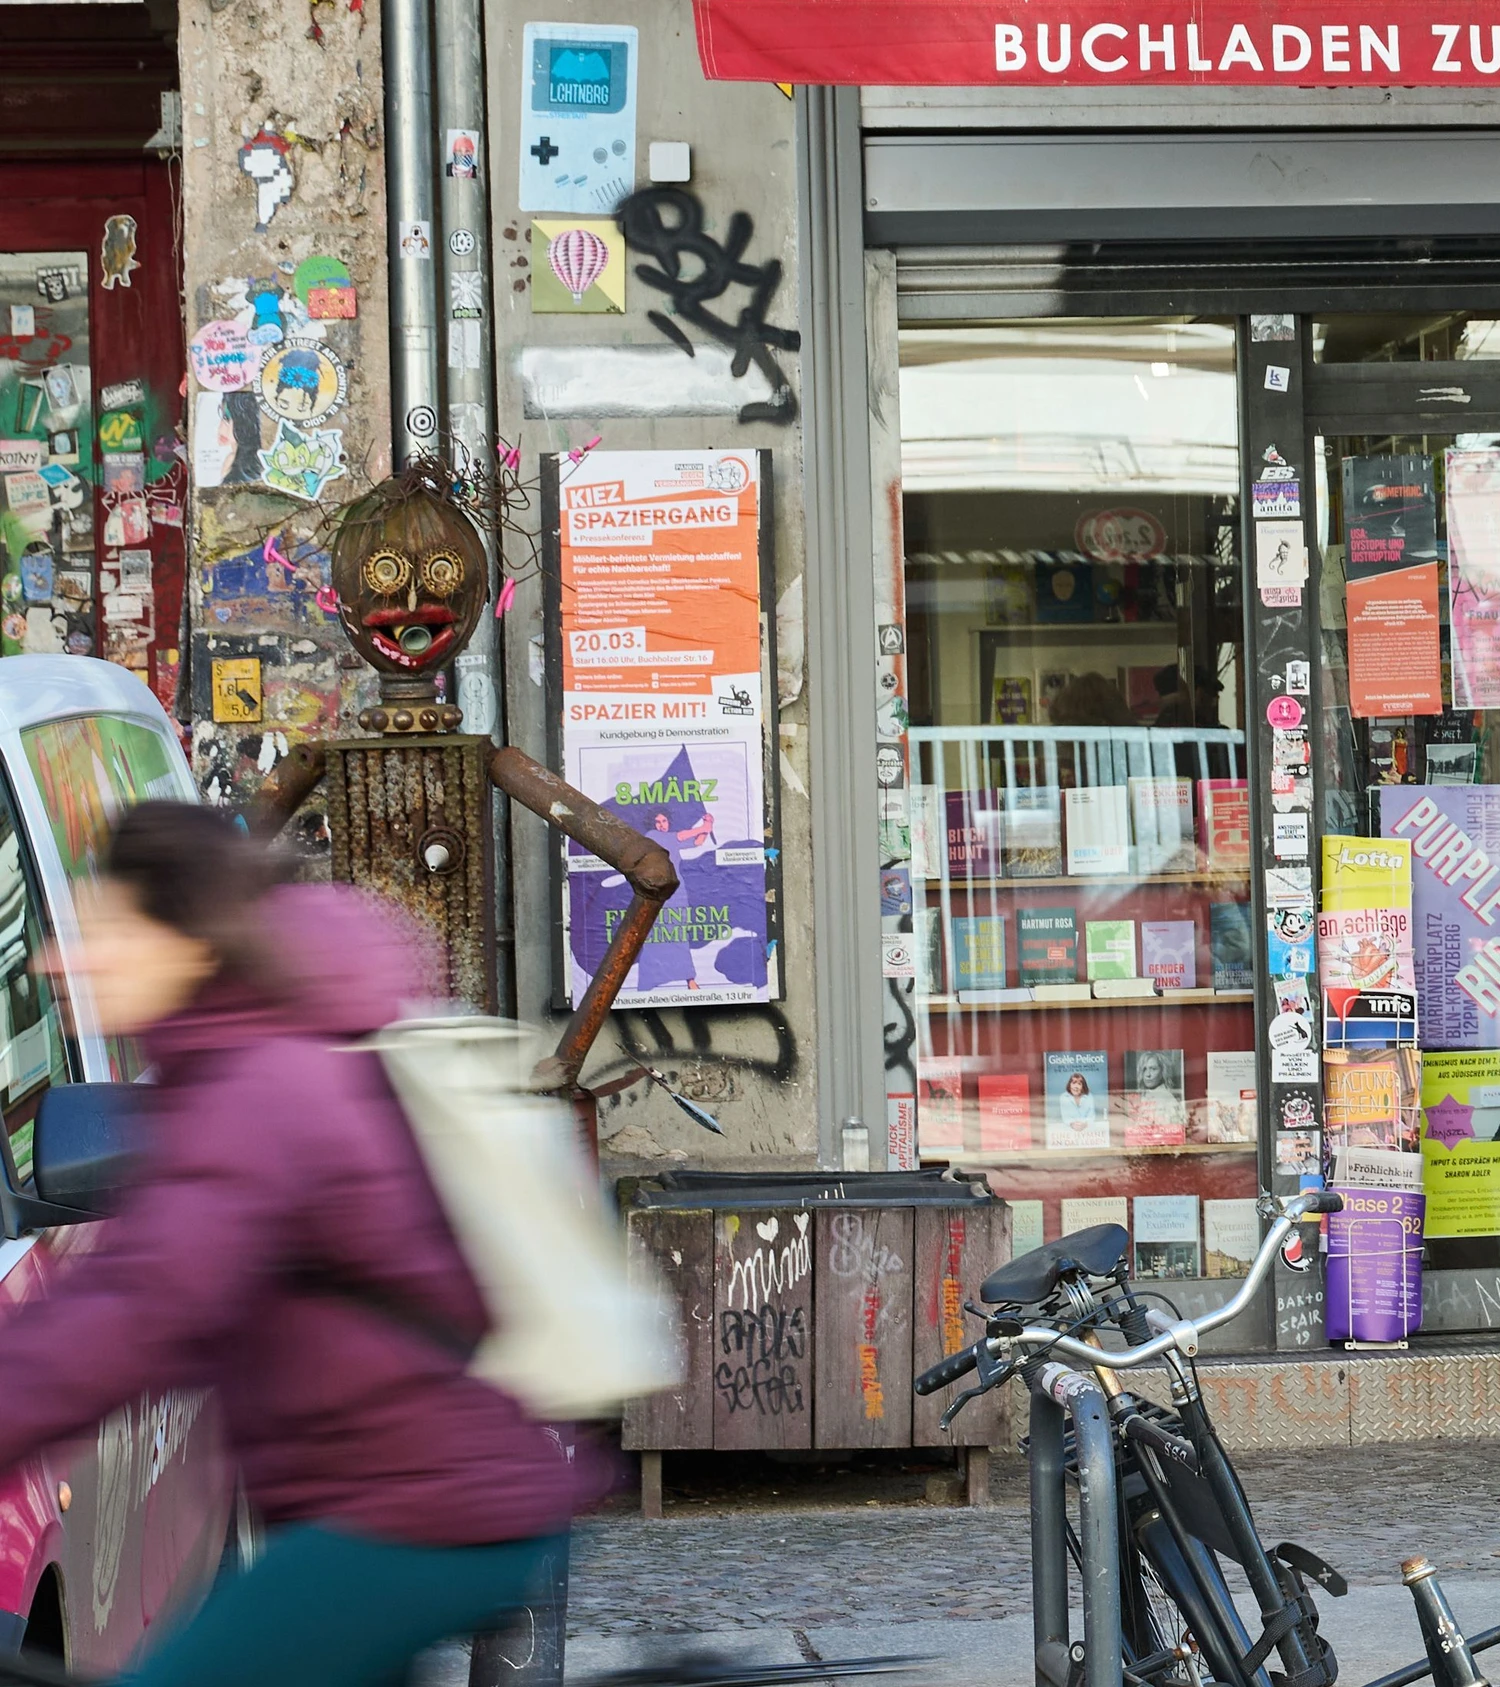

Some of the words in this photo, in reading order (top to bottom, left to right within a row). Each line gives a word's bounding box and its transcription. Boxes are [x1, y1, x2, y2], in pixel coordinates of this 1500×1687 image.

[993, 23, 1401, 73] BUCHLADEN
[550, 82, 609, 105] LCHTNBRG
[284, 338, 321, 351] STREET
[321, 348, 341, 364] ART
[336, 364, 347, 403] CONTRA
[302, 415, 327, 428] ODIO
[569, 483, 622, 508] KIEZ
[1260, 504, 1293, 513] antifa
[573, 505, 731, 530] SPAZIERGANG
[580, 534, 645, 542] Pressekonferenz
[1351, 539, 1387, 551] DYSTOPIE
[1388, 538, 1405, 550] UND
[649, 554, 695, 563] Vermietung
[696, 552, 742, 561] abschaffen!
[573, 566, 587, 574] Für
[588, 565, 611, 573] echte
[612, 564, 671, 574] Nachbarschaft!
[574, 632, 642, 653] 20.03.
[575, 656, 595, 665] Start
[620, 655, 637, 666] Uhr,
[638, 655, 682, 664] Buchholzer
[684, 654, 697, 663] Str.
[698, 655, 708, 663] 16
[231, 704, 250, 717] 5,0
[570, 703, 656, 721] SPAZIER
[662, 702, 707, 719] MIT!
[599, 729, 657, 740] Kundgebung
[666, 727, 729, 737] Demonstration
[615, 777, 719, 805] 8.MÄRZ
[1467, 793, 1482, 841] FIGHTS
[1485, 793, 1500, 857] FEMINIST
[949, 827, 985, 844] BITCH
[949, 844, 984, 861] HUNT
[1339, 847, 1404, 868] Lotta
[1021, 917, 1053, 930] HARTMUT
[1054, 917, 1074, 929] ROSA
[1148, 963, 1185, 975] GENDER
[1426, 912, 1443, 1039] MARIANNENPLATZ
[1154, 976, 1181, 987] UNKS
[1444, 924, 1461, 1039] BLN-KREUZBERG
[726, 993, 736, 1001] 13
[738, 992, 752, 1000] Uhr
[1368, 998, 1412, 1014] info
[1462, 998, 1479, 1037] 12PM
[1048, 1054, 1074, 1064] Gisèle
[1076, 1053, 1105, 1064] Pelicot
[1423, 1059, 1458, 1068] EMINISMUS
[1460, 1058, 1476, 1066] NACH
[1451, 1069, 1485, 1078] JÜDISCHER
[1329, 1070, 1394, 1093] HALTUNG
[889, 1124, 898, 1155] FUCK
[898, 1101, 907, 1170] APITALISME
[1430, 1158, 1450, 1167] INPUT
[1458, 1155, 1491, 1165] GESPRÄCH
[1348, 1163, 1413, 1178] »Fröhlichkit
[1445, 1171, 1470, 1179] SHARON
[1472, 1169, 1491, 1178] ADLER
[1376, 1177, 1414, 1189] Arbet«
[1391, 1196, 1403, 1215] 2
[1146, 1221, 1186, 1230] Exilanten
[1212, 1222, 1256, 1231] Vertraute
[1402, 1216, 1422, 1235] 62
[1217, 1233, 1252, 1243] Fremde
